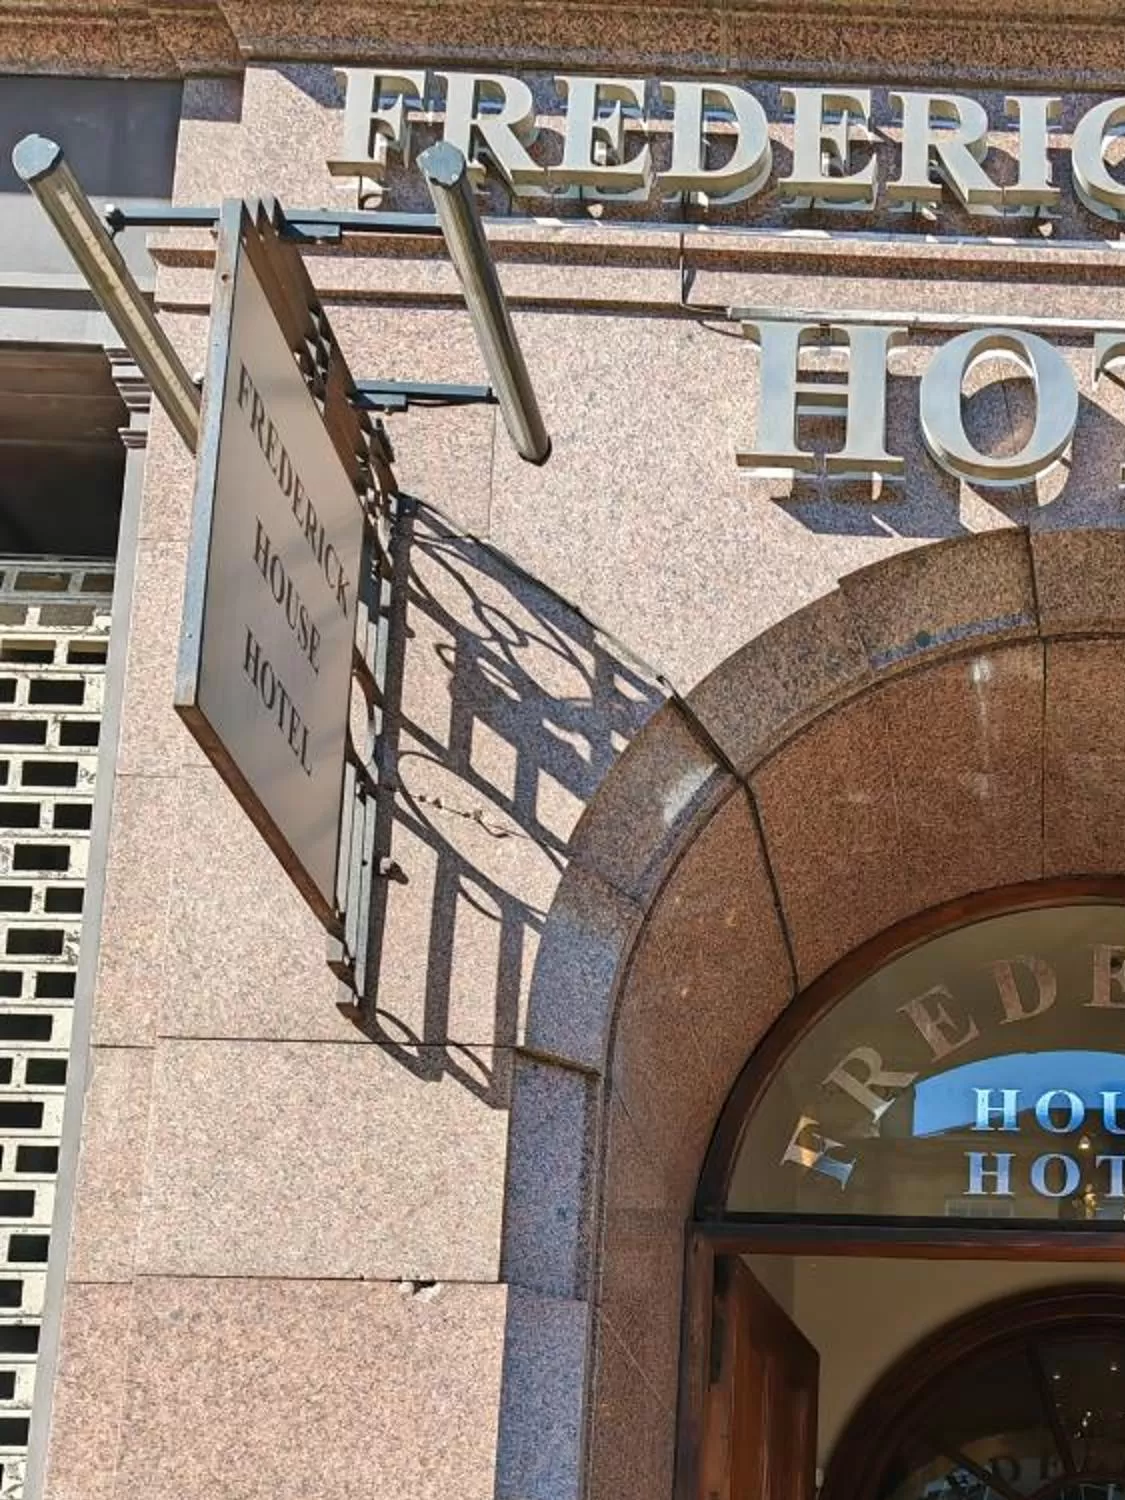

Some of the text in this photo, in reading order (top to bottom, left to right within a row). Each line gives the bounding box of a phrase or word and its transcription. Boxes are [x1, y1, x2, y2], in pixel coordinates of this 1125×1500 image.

[237, 363, 349, 618] FREDERICK
[252, 515, 321, 675] HOUSE
[242, 625, 312, 777] HOTEL
